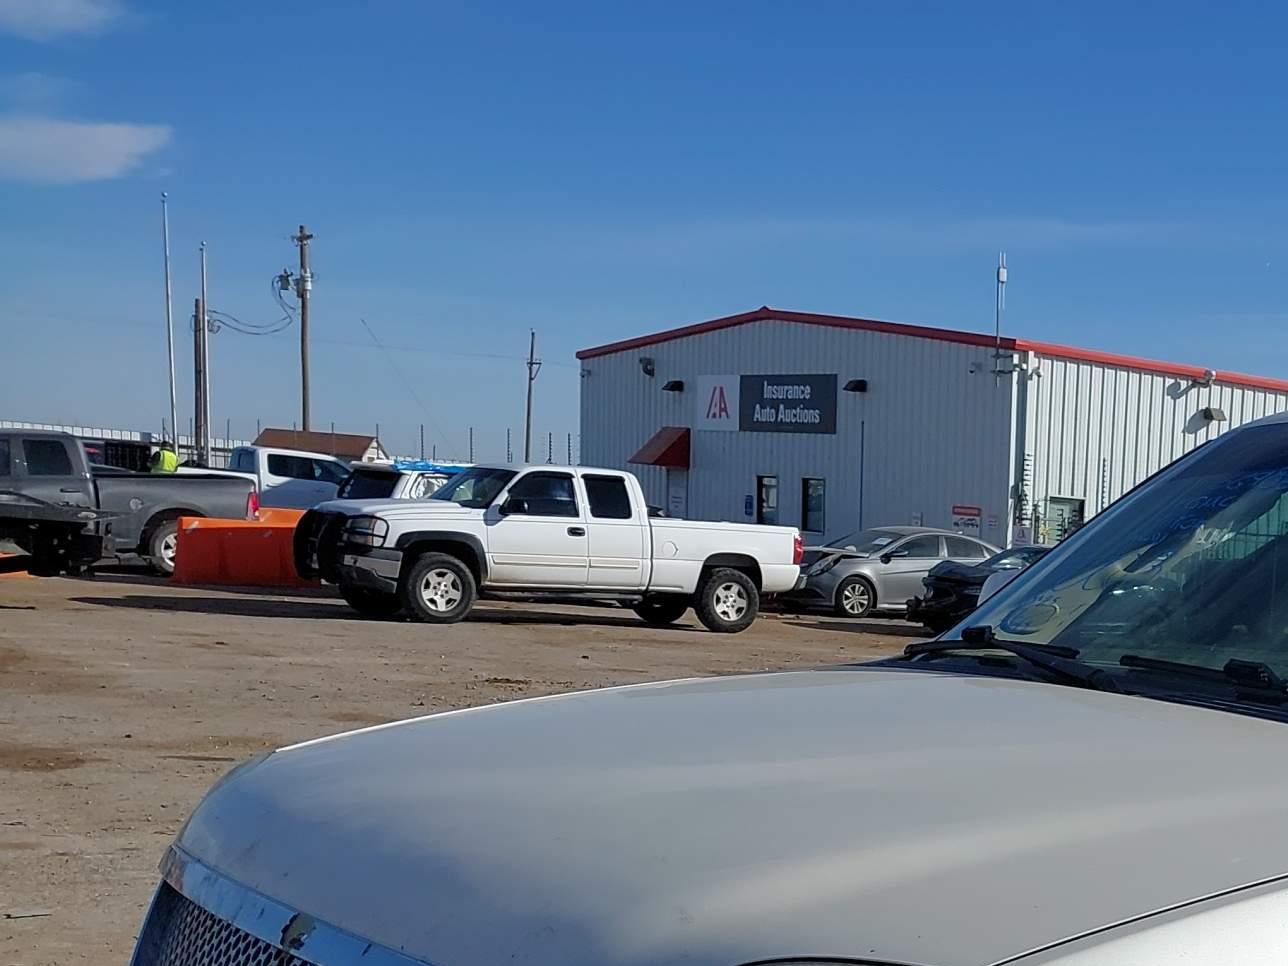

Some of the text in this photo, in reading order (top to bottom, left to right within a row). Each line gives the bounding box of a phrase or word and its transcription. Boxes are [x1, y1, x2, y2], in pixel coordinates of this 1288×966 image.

[763, 381, 811, 400] Insurance
[753, 403, 820, 424] Auto Auctions
